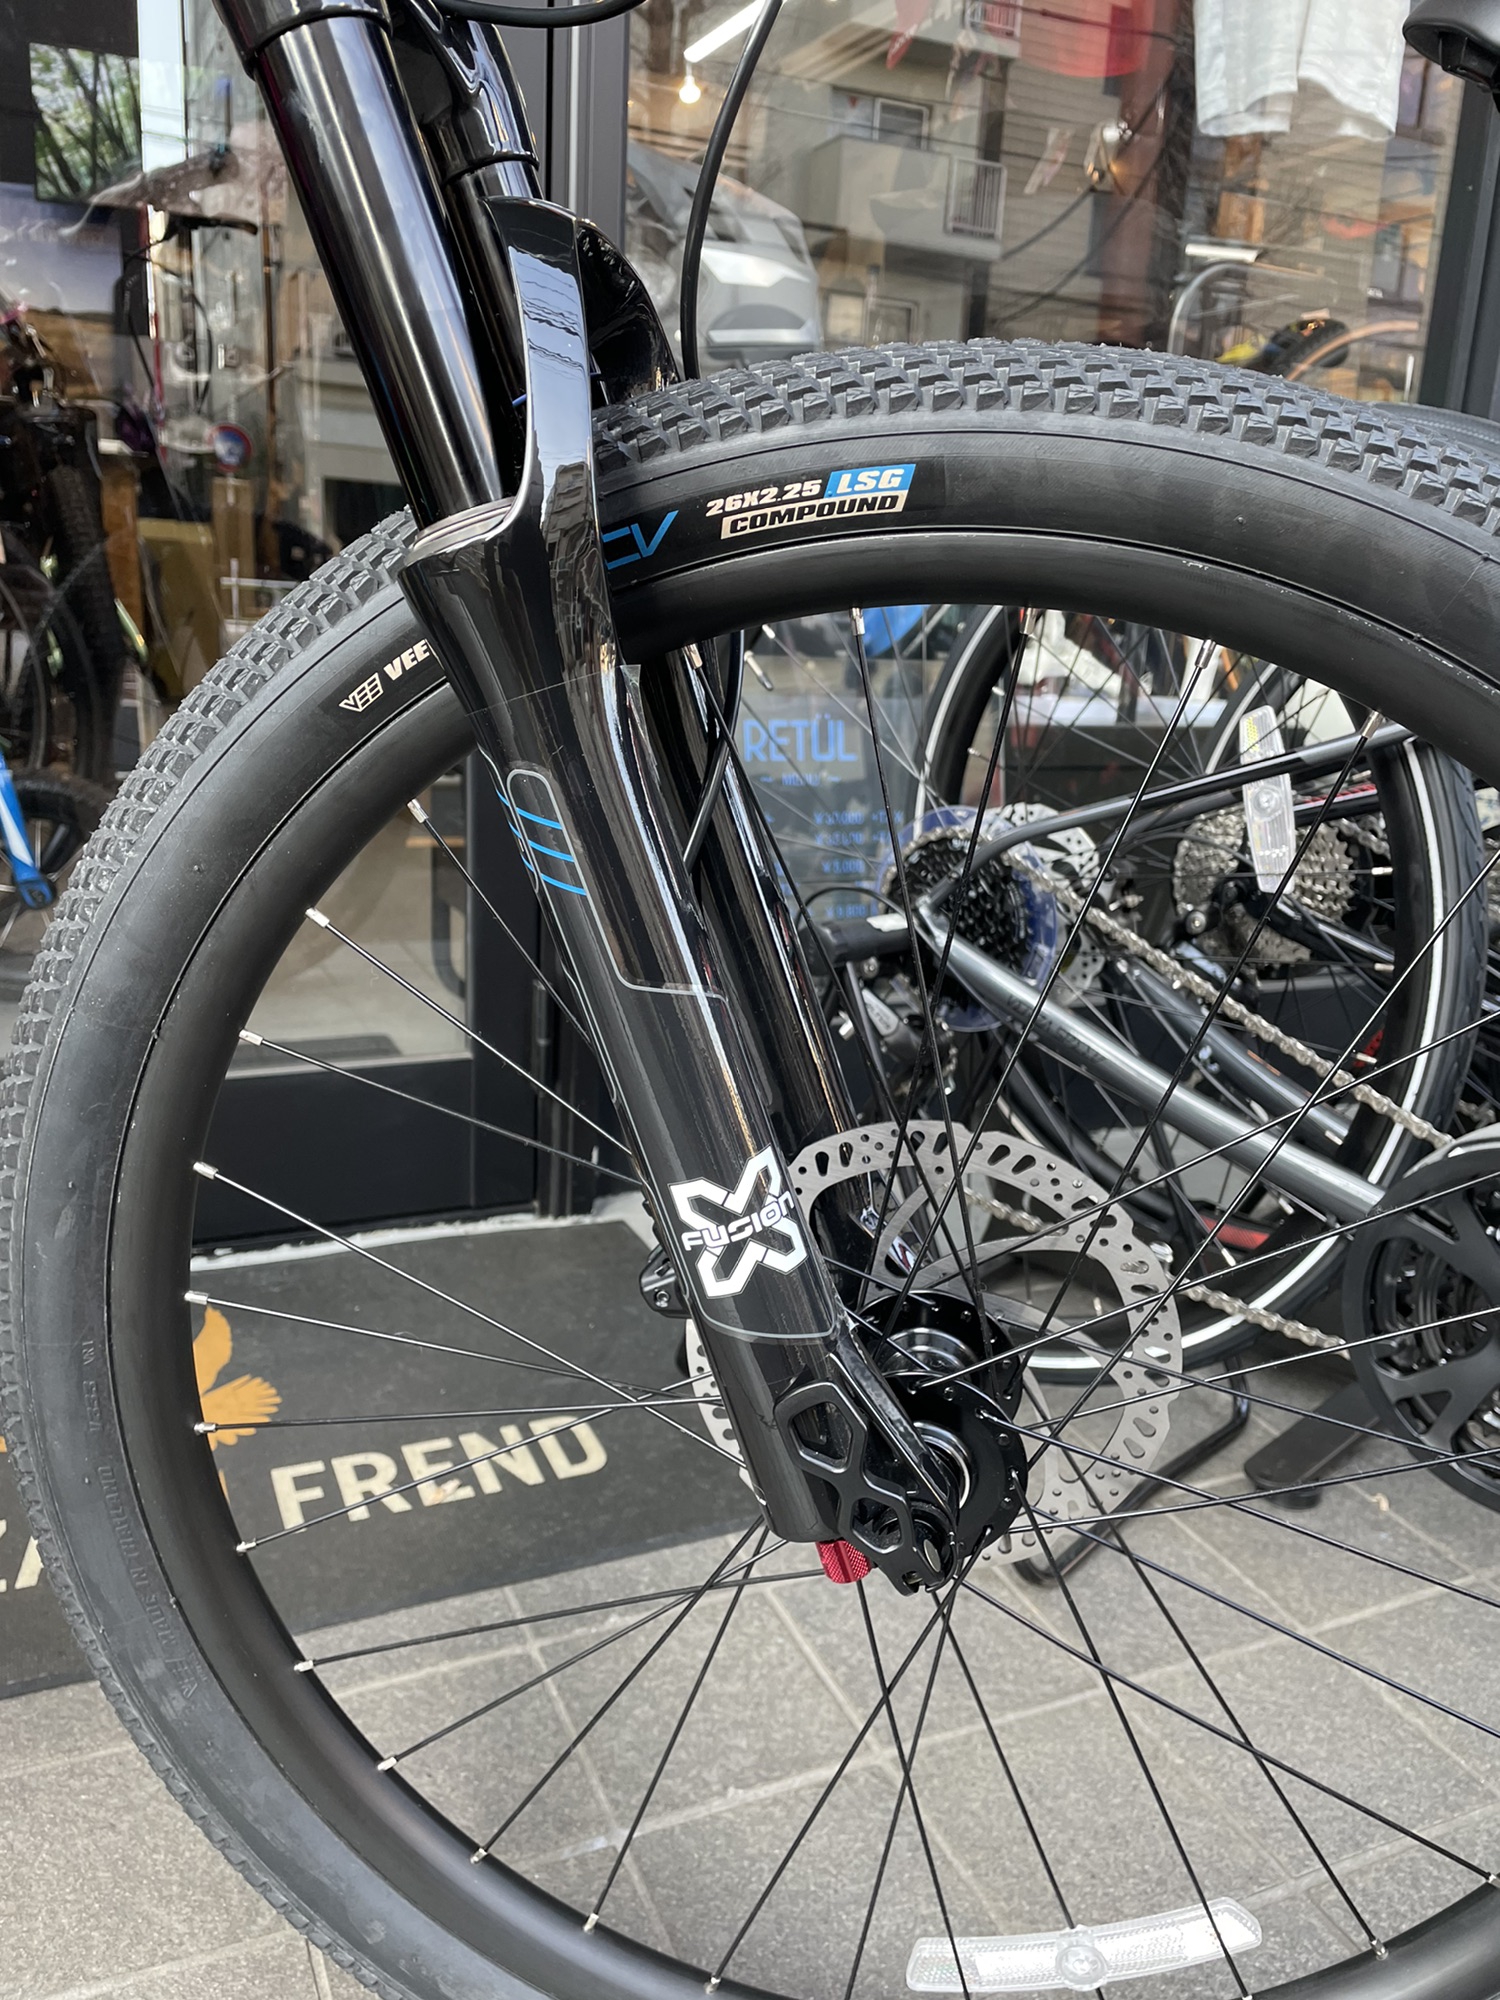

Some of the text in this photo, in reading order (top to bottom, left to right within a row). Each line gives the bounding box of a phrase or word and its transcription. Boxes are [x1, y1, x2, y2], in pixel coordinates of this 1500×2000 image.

[706, 468, 906, 517] 26X2.25 LSG
[728, 494, 900, 535] COMPOUND
[383, 639, 430, 681] VEE
[742, 713, 858, 762] RETÜL
[269, 1415, 609, 1532] FREND
